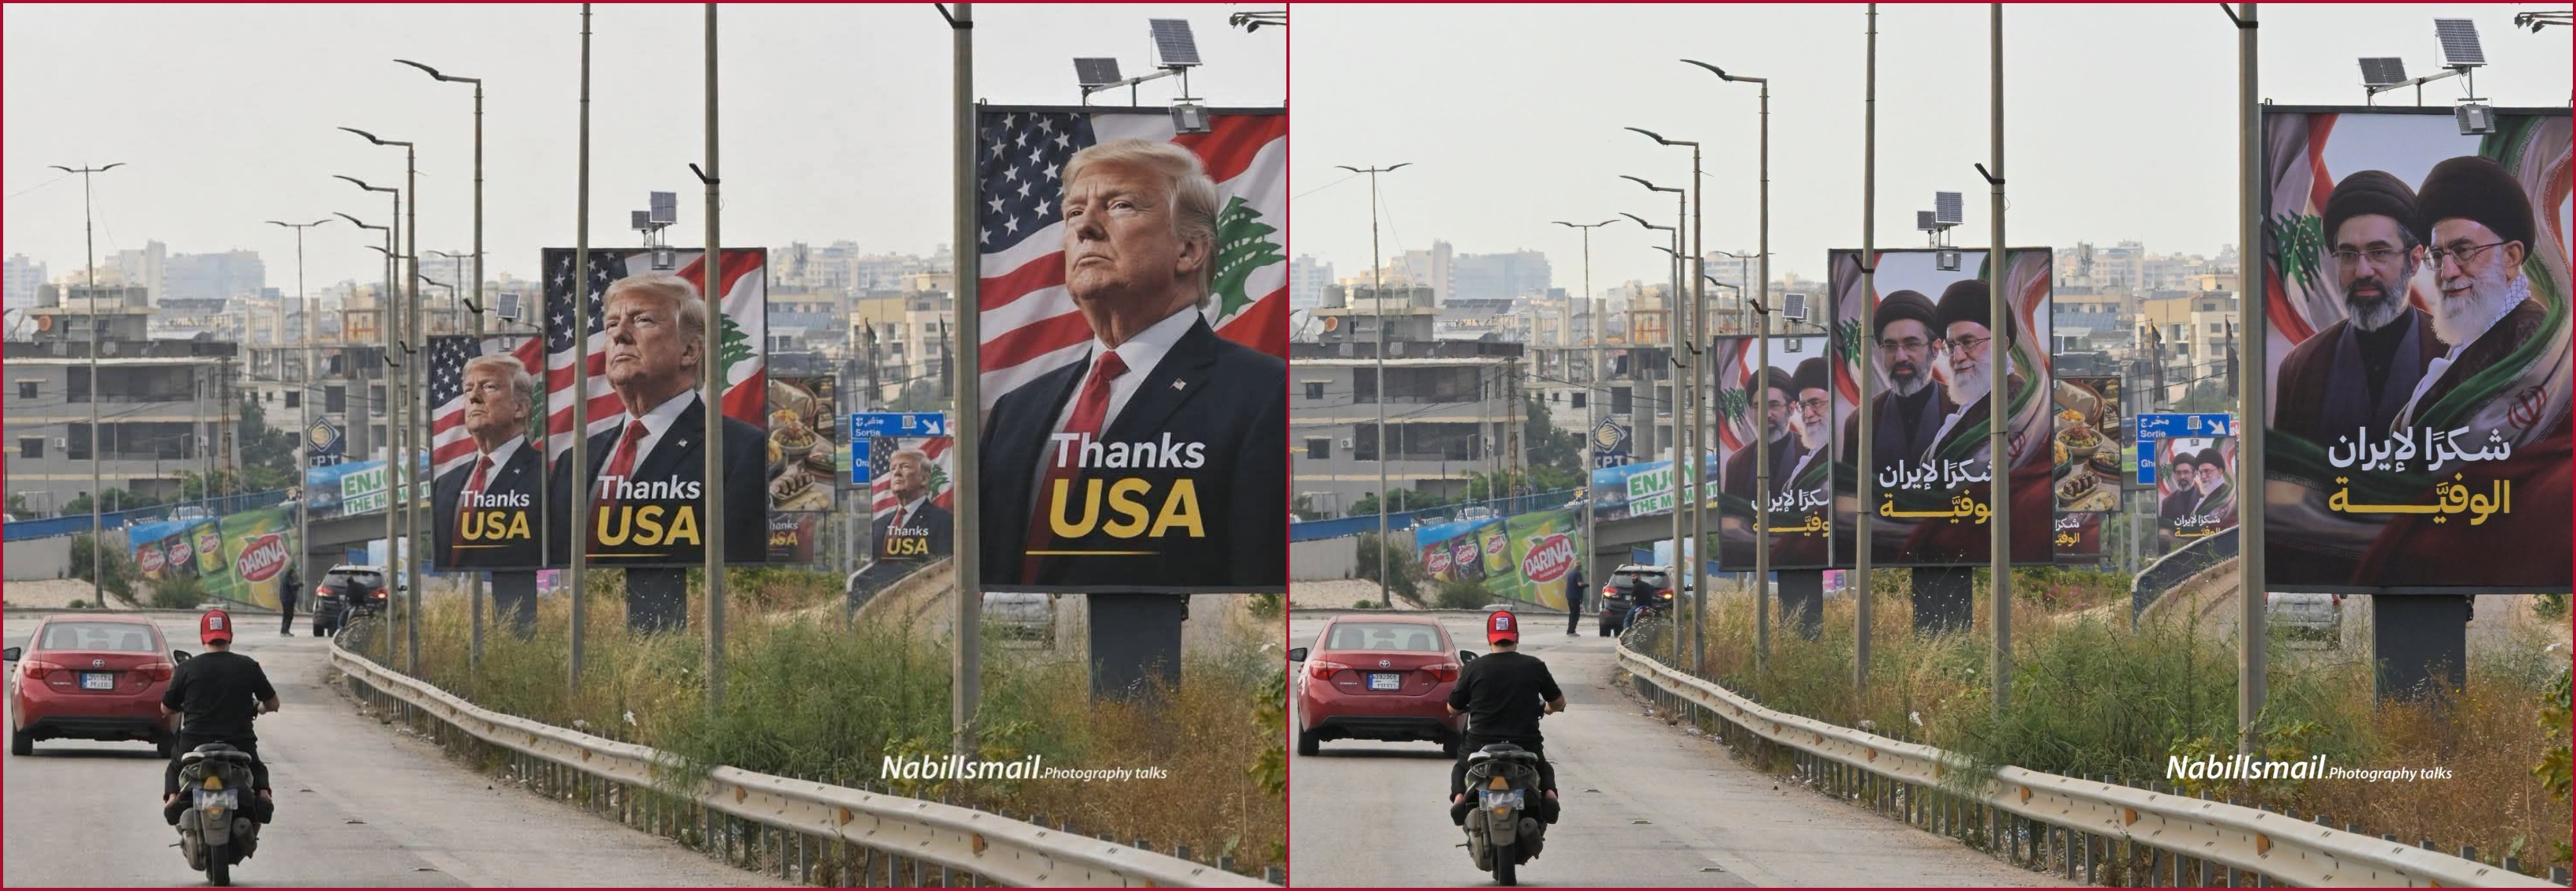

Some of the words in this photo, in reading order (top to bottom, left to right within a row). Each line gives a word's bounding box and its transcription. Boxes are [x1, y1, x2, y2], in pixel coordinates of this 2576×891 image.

[2140, 416, 2170, 428] مخرج
[2140, 429, 2166, 438] Sortie
[1051, 432, 1206, 469] Thanks
[2328, 426, 2417, 473] لإيران
[2425, 425, 2511, 472] شكرًا
[597, 474, 701, 500] Thanks
[1879, 459, 1938, 490] لإيران
[346, 496, 371, 513] THE
[461, 489, 530, 507] Thanks
[1050, 477, 1206, 538] USA
[1631, 496, 1658, 514] THE
[461, 511, 531, 540] USA
[597, 505, 701, 546] USA
[769, 519, 798, 530] hanks
[887, 526, 929, 536] Thanks
[239, 538, 288, 576] DARINA
[887, 538, 929, 555] USA
[1525, 537, 1575, 576] DARINA
